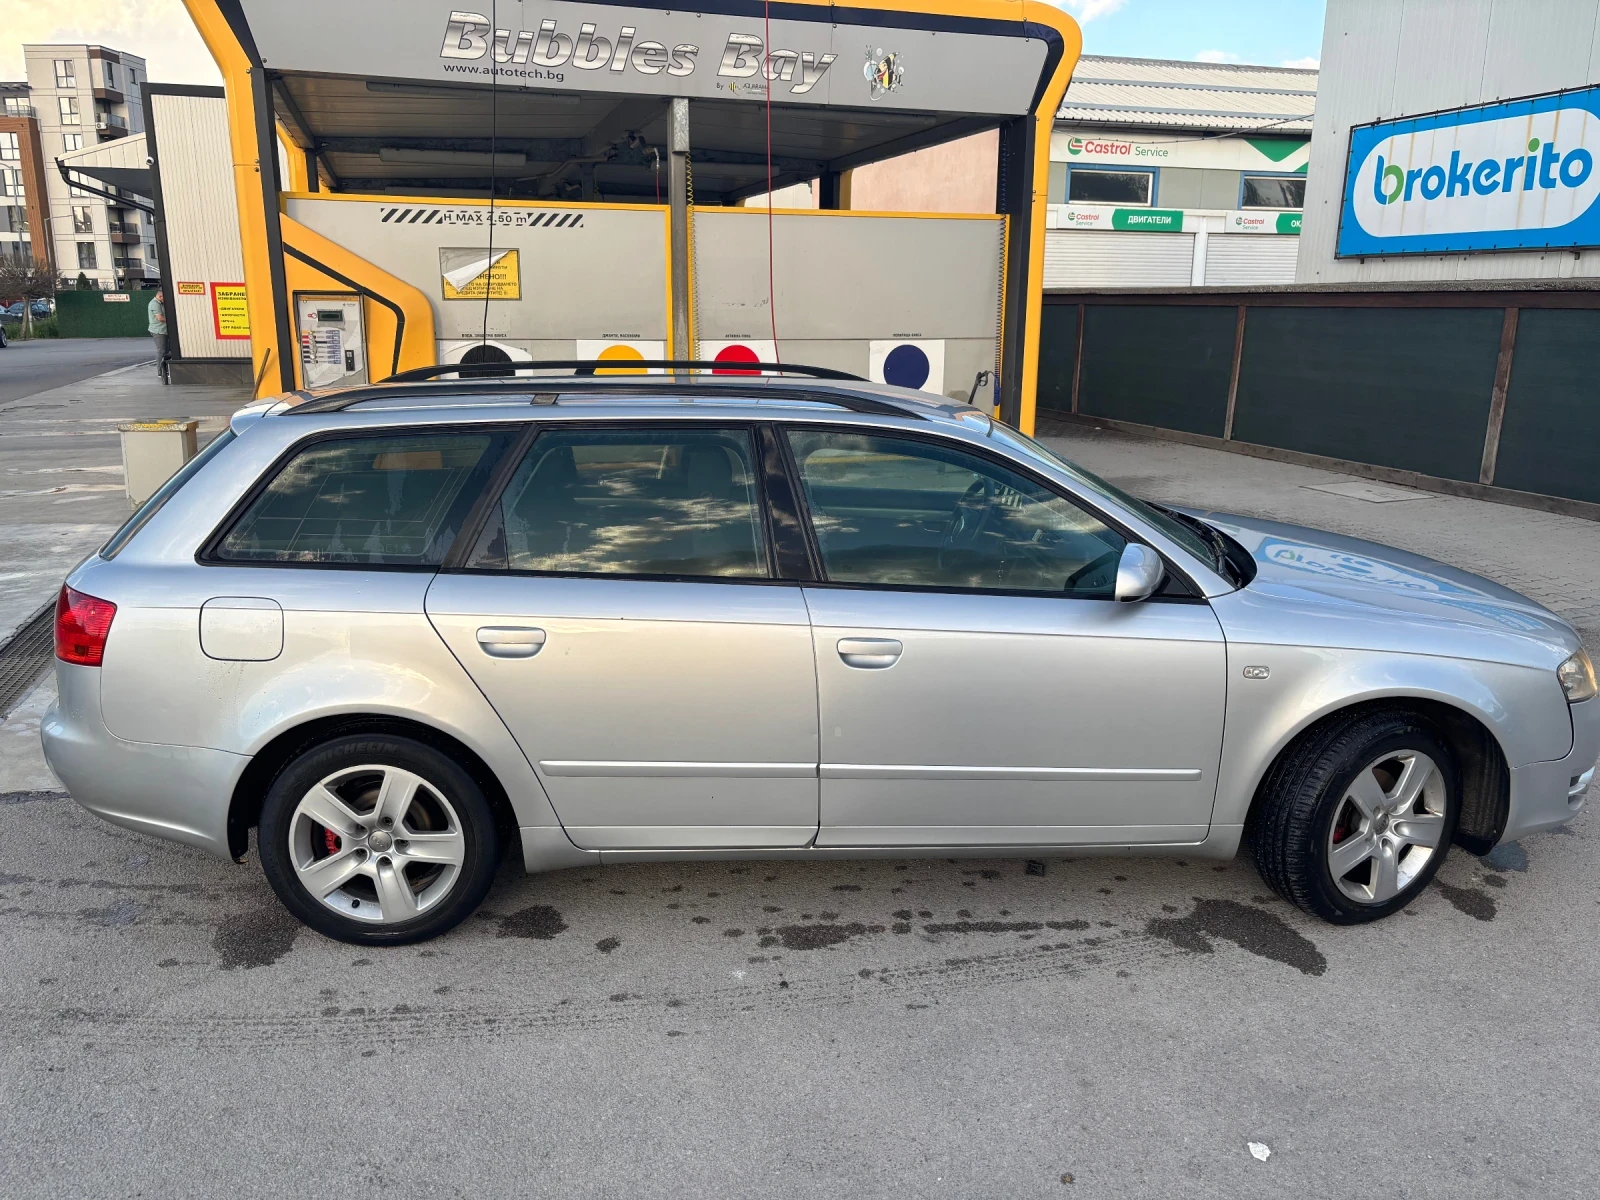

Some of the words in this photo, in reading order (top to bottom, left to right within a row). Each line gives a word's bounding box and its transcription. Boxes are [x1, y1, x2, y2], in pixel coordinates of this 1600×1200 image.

[440, 10, 700, 77] Bubbles
[717, 33, 838, 94] Bay
[443, 64, 565, 82] www.autotech.bg
[716, 82, 724, 90] By
[1084, 141, 1132, 155] Castrol
[1135, 146, 1169, 157] Service
[1373, 137, 1594, 206] brokerito
[443, 213, 452, 221] H
[456, 213, 483, 222] MAX
[486, 214, 512, 223] 4.50
[1076, 213, 1100, 221] Castrol
[1127, 215, 1172, 225] ДВИГАТЕЛИ
